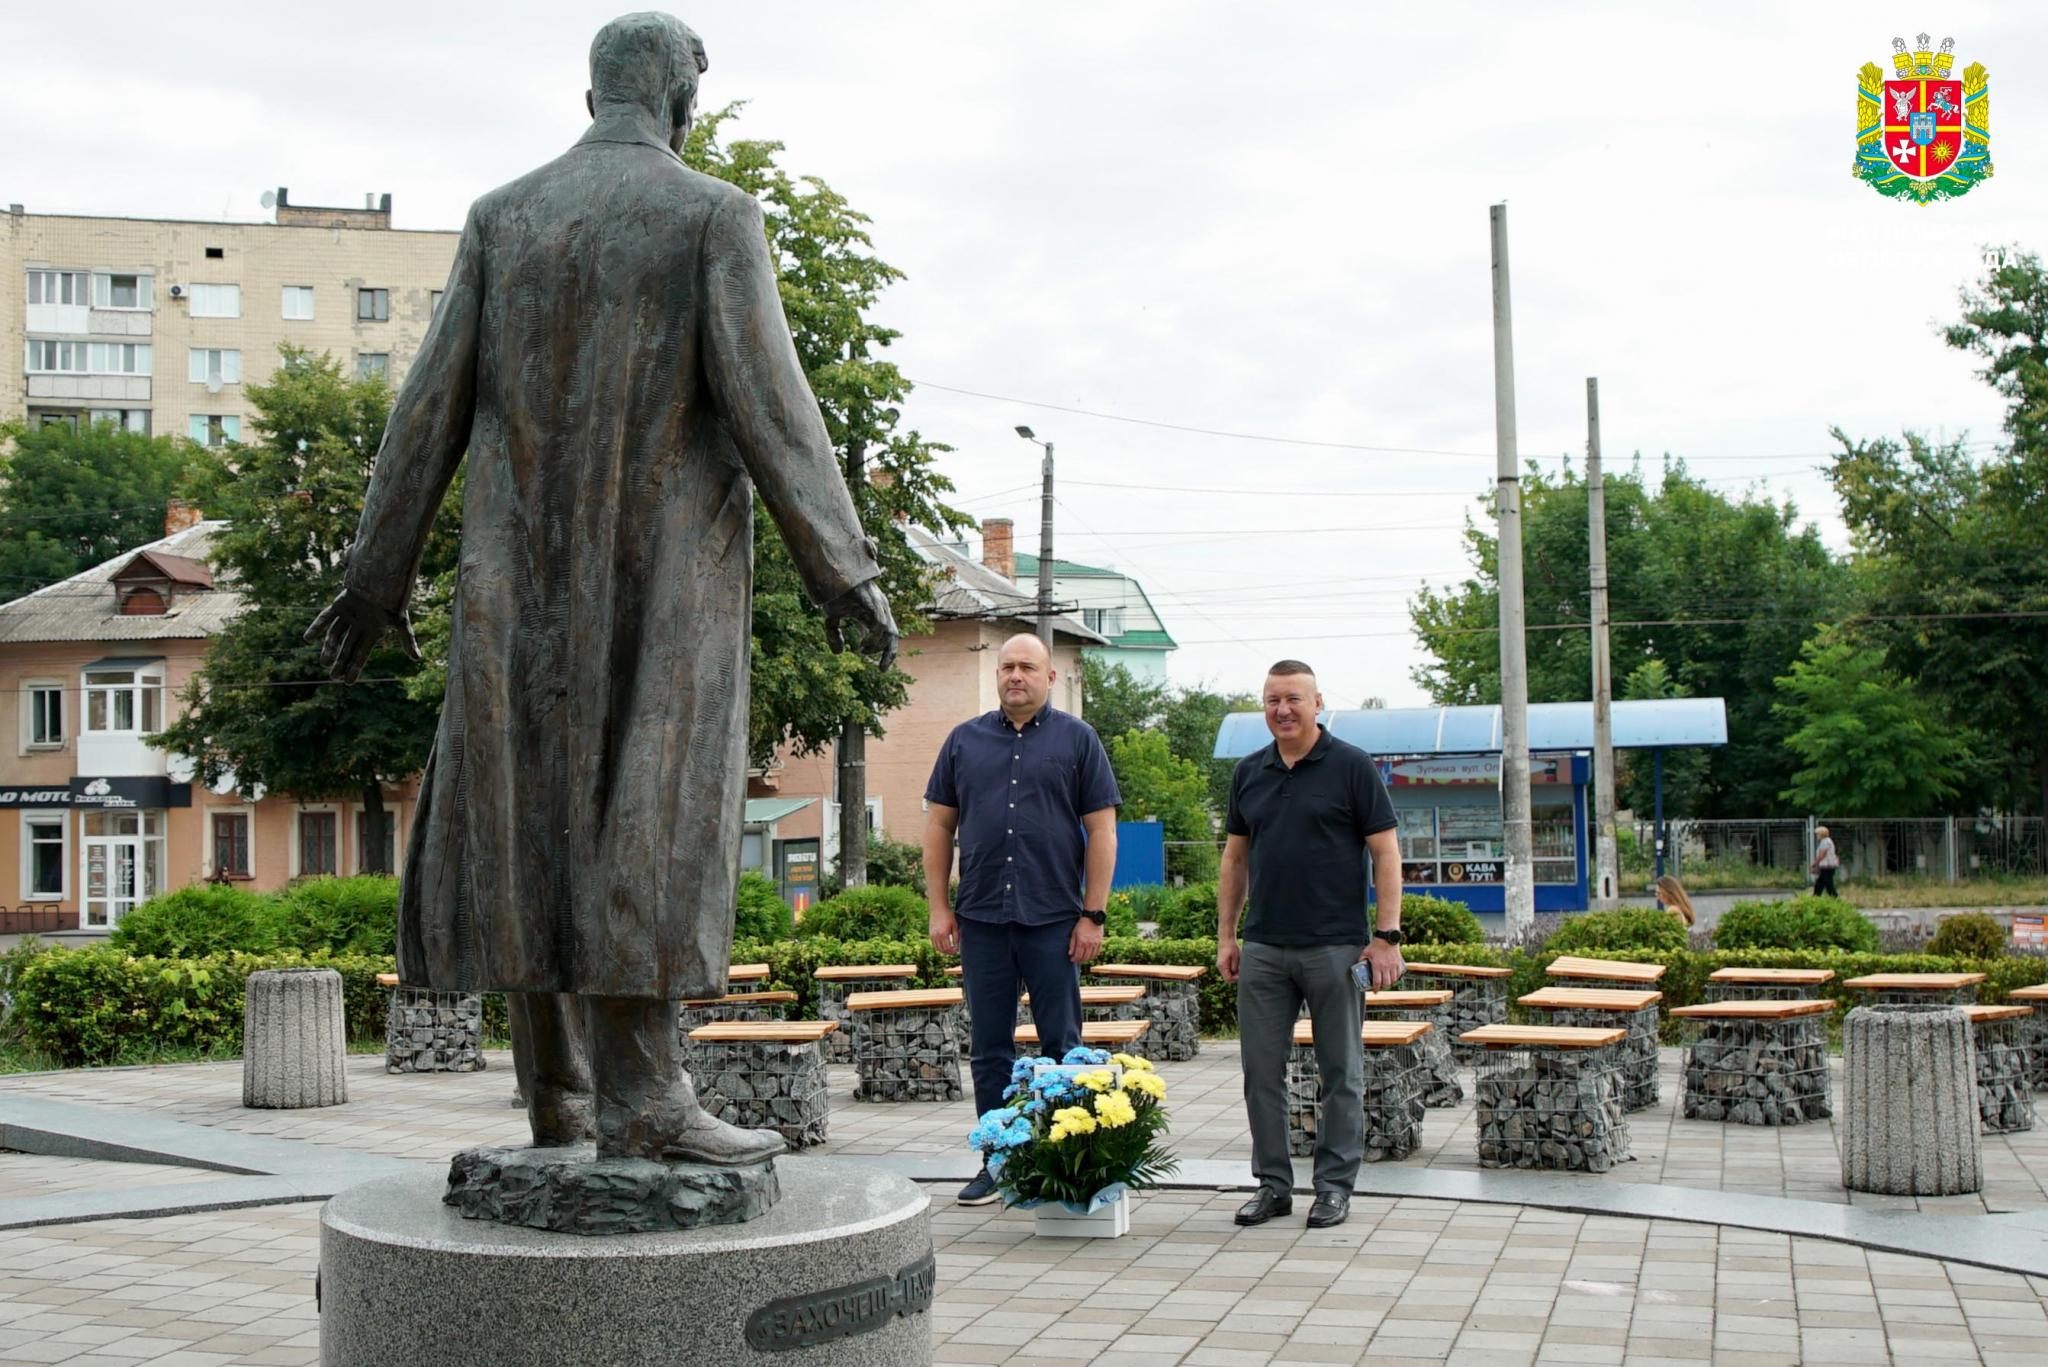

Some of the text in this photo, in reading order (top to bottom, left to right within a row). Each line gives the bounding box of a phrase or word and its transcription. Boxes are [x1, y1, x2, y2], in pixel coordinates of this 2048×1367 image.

[1416, 765, 1456, 776] Зупинка
[1465, 863, 1497, 872] КАВА
[1469, 872, 1494, 882] ТУТ!
